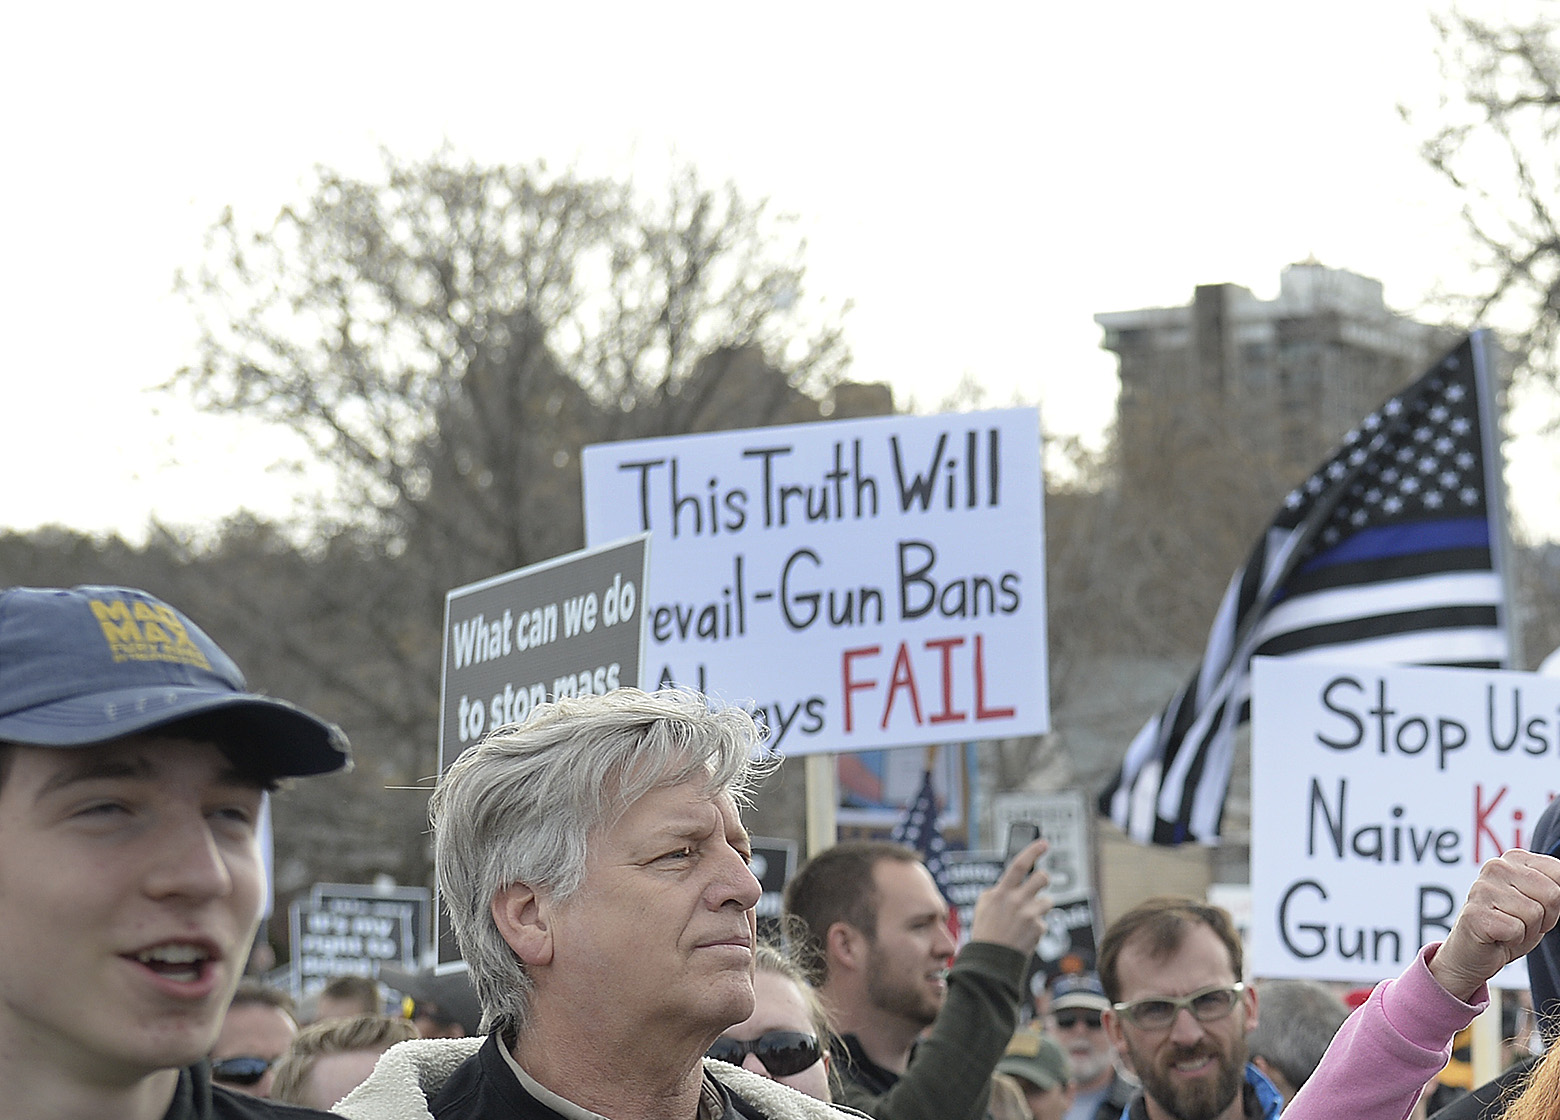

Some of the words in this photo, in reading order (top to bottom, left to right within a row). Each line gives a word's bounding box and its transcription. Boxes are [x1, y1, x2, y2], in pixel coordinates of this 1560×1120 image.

[618, 459, 746, 539] This
[743, 440, 877, 529] Truth
[892, 429, 1001, 512] Will
[453, 608, 513, 671] What
[516, 603, 558, 651] can
[563, 591, 598, 639] we
[602, 572, 636, 628] do
[898, 541, 1021, 622] Bans
[458, 695, 485, 743] to
[841, 634, 1016, 733] FAIL
[1315, 676, 1468, 771] Stop
[1307, 777, 1461, 865] Naive
[1276, 881, 1401, 962] Gun
